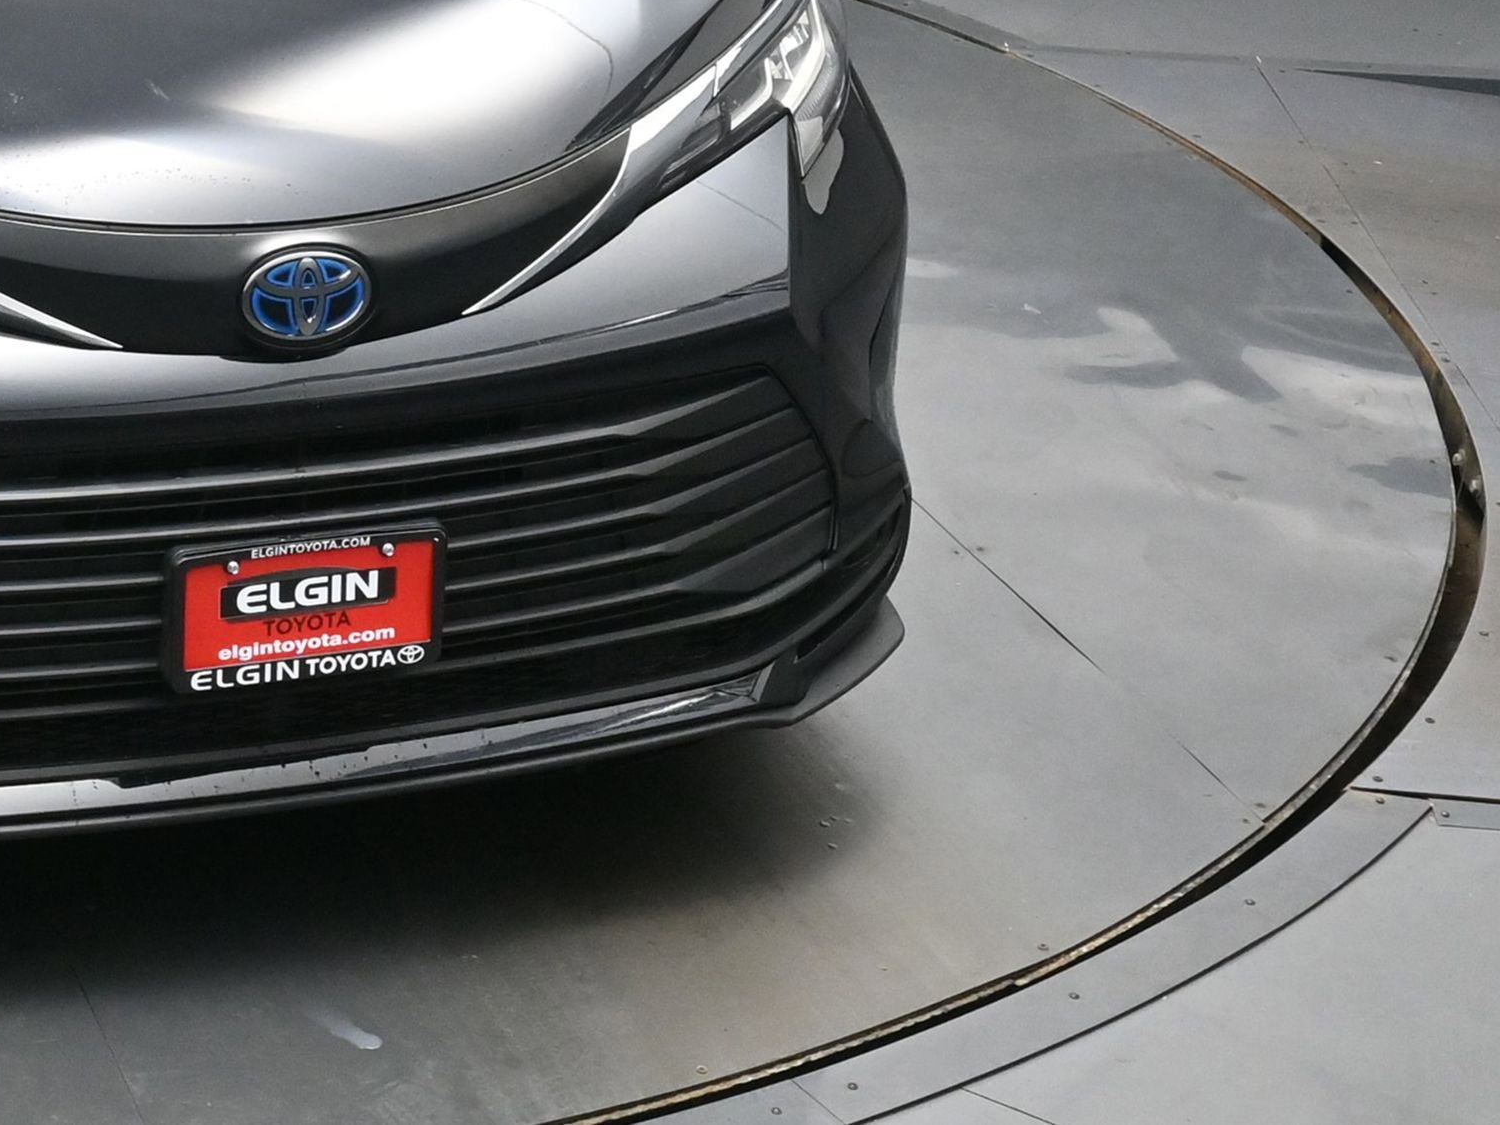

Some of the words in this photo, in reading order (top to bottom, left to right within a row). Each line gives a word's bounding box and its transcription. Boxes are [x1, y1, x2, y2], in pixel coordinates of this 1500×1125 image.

[250, 536, 371, 560] ELGINTOYOTA.COM
[236, 569, 380, 615] ELGIN
[263, 611, 351, 637] TOYOTA
[217, 626, 396, 661] elgintoyota.com
[190, 659, 301, 692] ELGIN
[305, 650, 397, 676] TOYOTA
